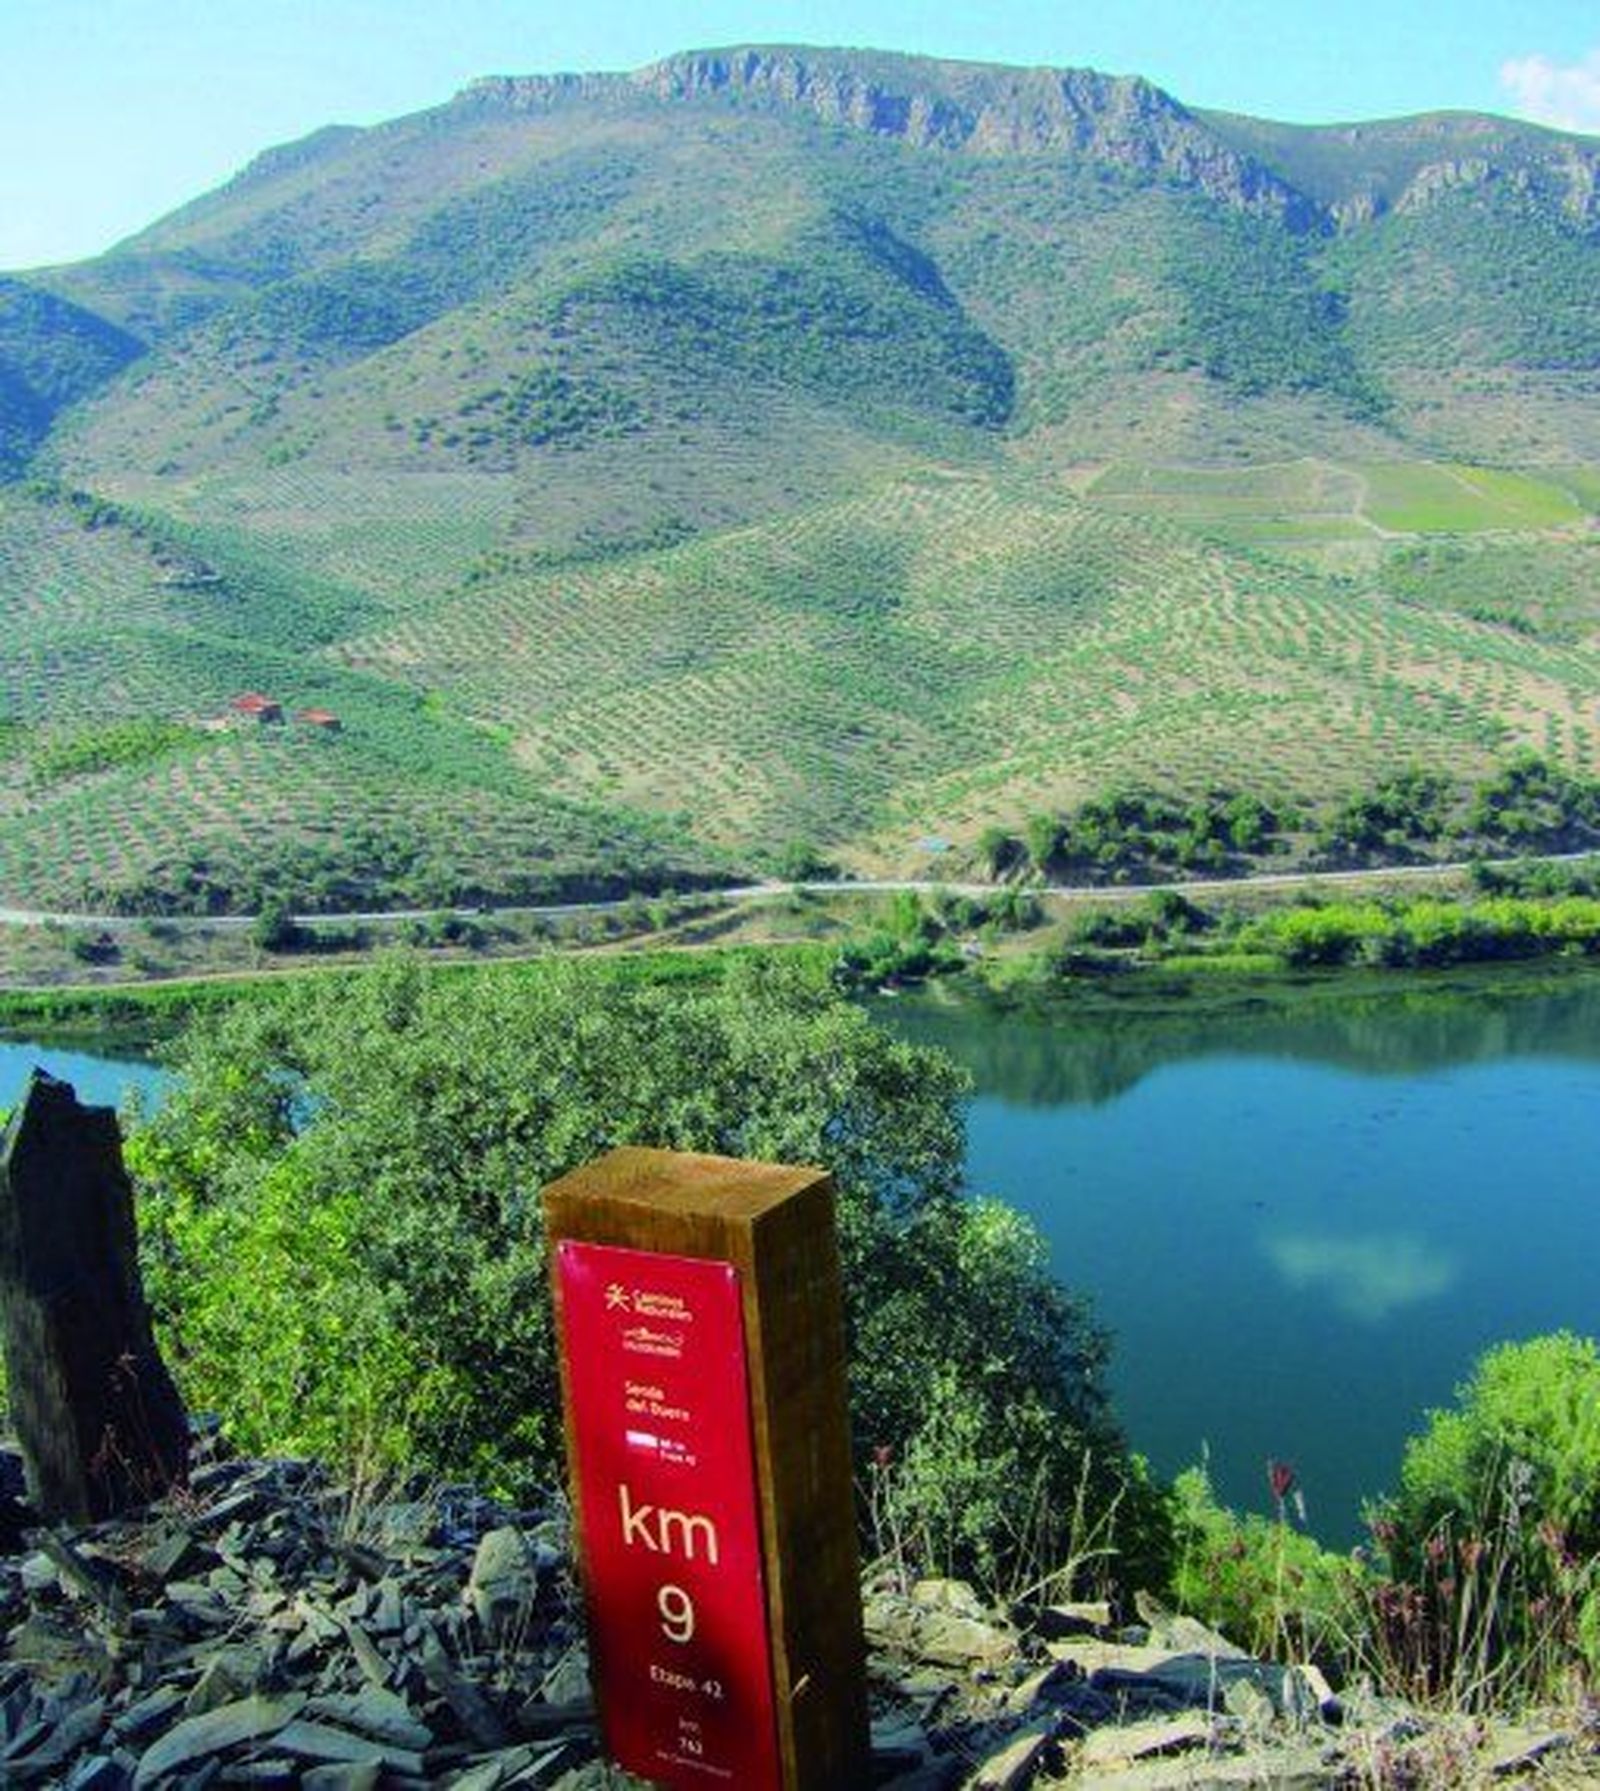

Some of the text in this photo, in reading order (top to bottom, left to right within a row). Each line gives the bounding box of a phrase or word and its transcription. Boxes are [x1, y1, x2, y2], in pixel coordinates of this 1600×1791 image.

[619, 1484, 717, 1565] km
[657, 1584, 694, 1642] 9
[650, 1665, 696, 1692] Etapa
